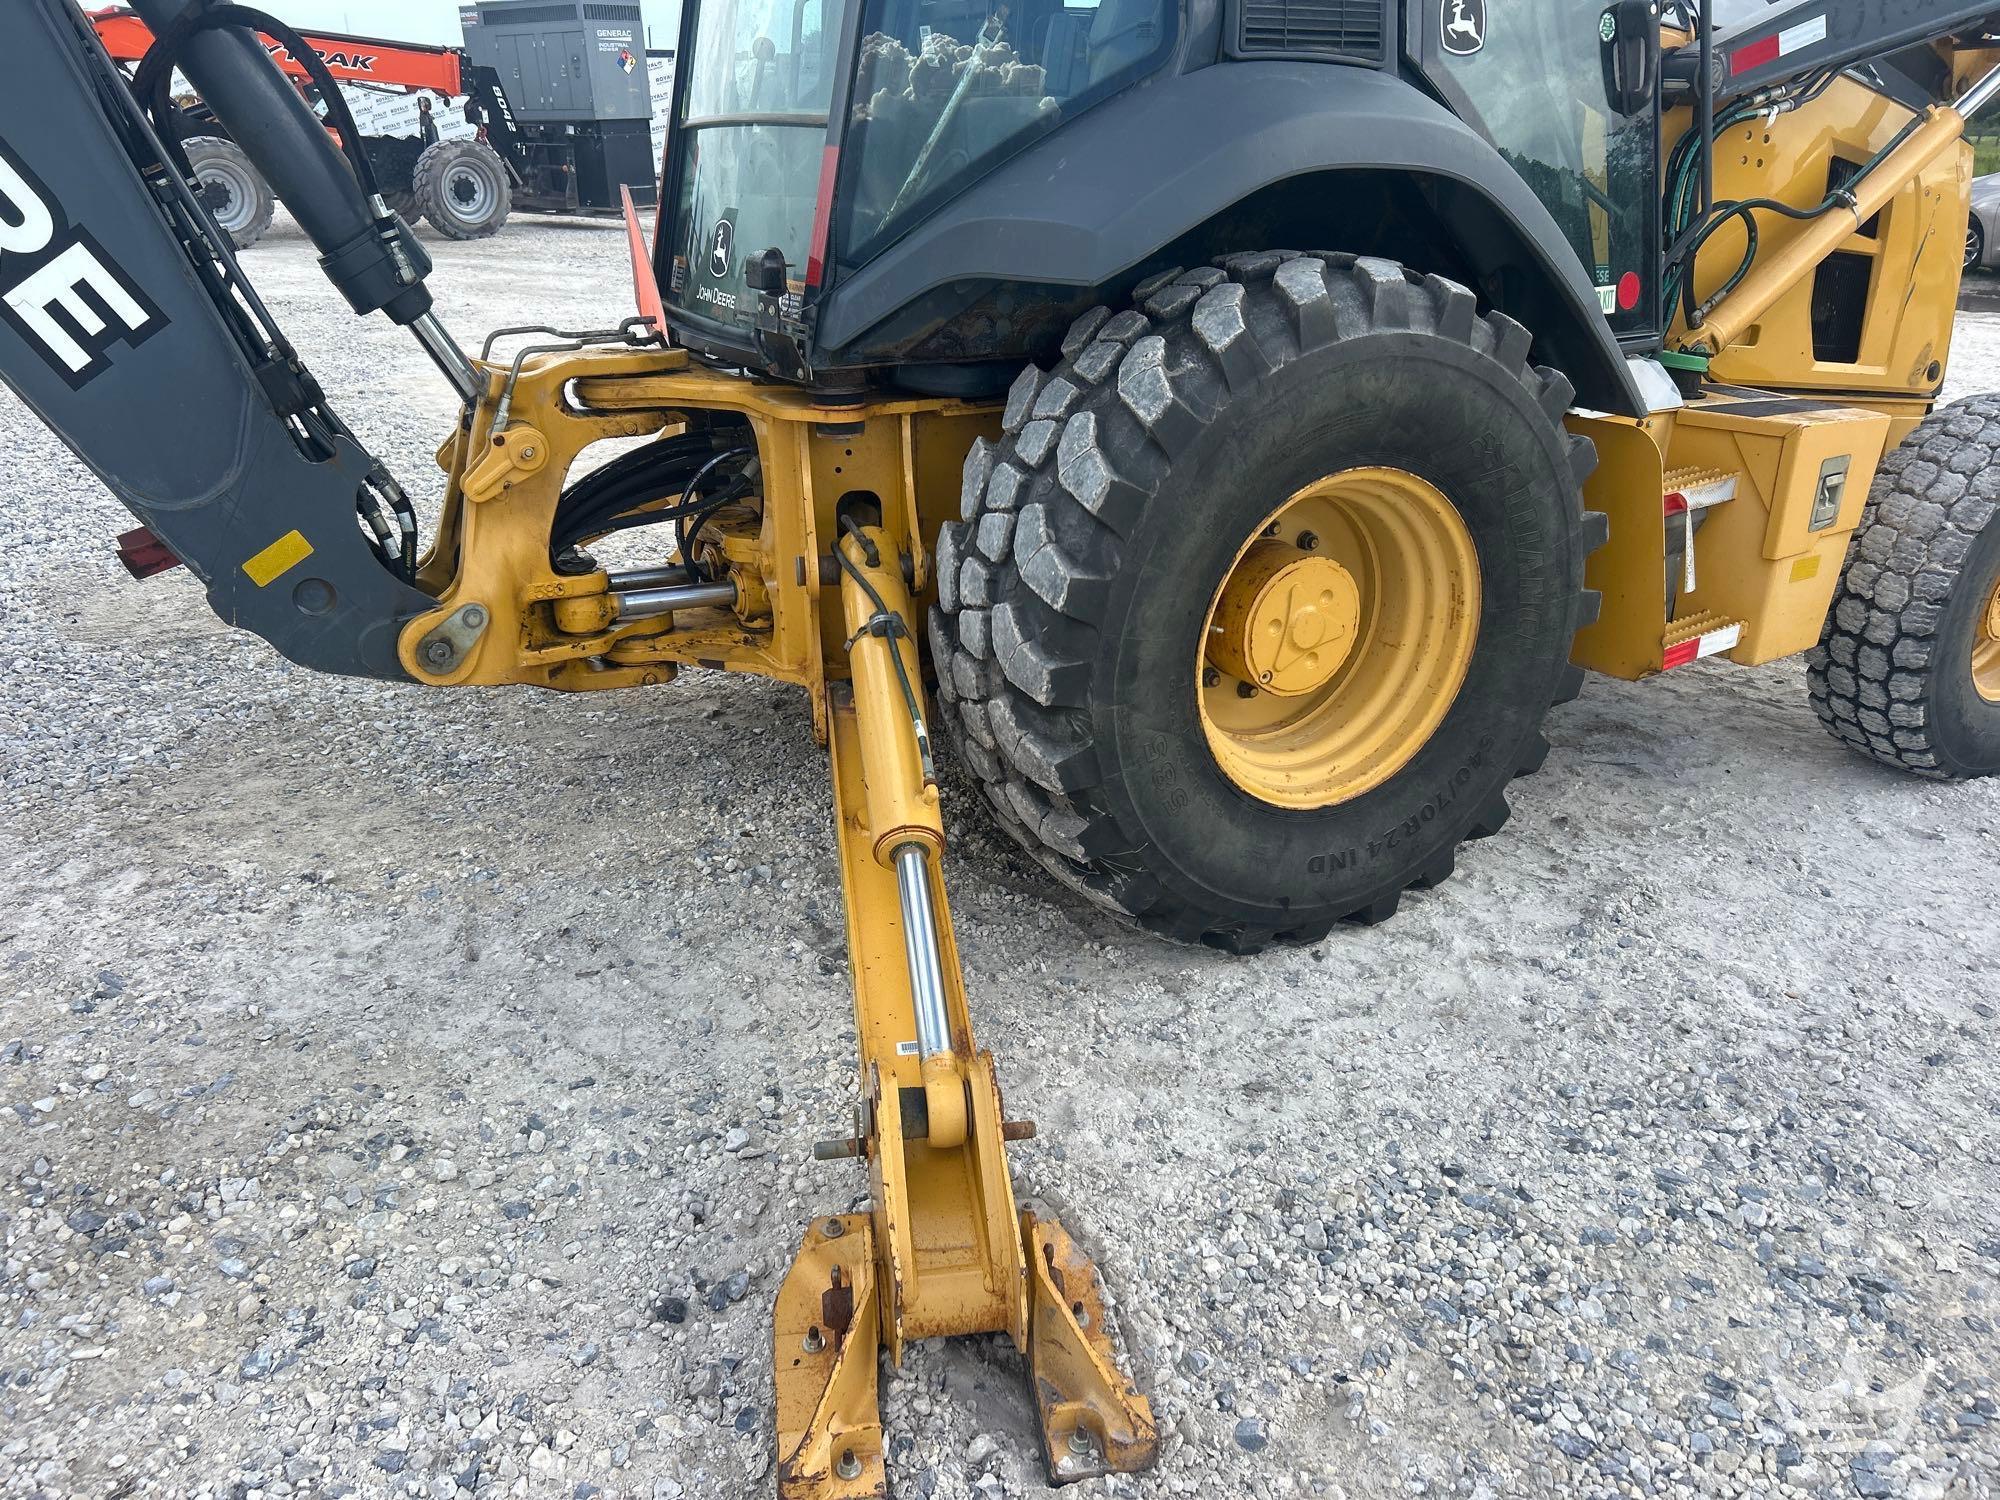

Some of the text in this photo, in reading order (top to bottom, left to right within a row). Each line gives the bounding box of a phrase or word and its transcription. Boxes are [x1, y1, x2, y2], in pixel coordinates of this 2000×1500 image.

[596, 29, 632, 37] GENERAC
[492, 86, 517, 132] 8042
[696, 284, 736, 309] JOHN DEERE
[1307, 848, 1357, 873] IND
